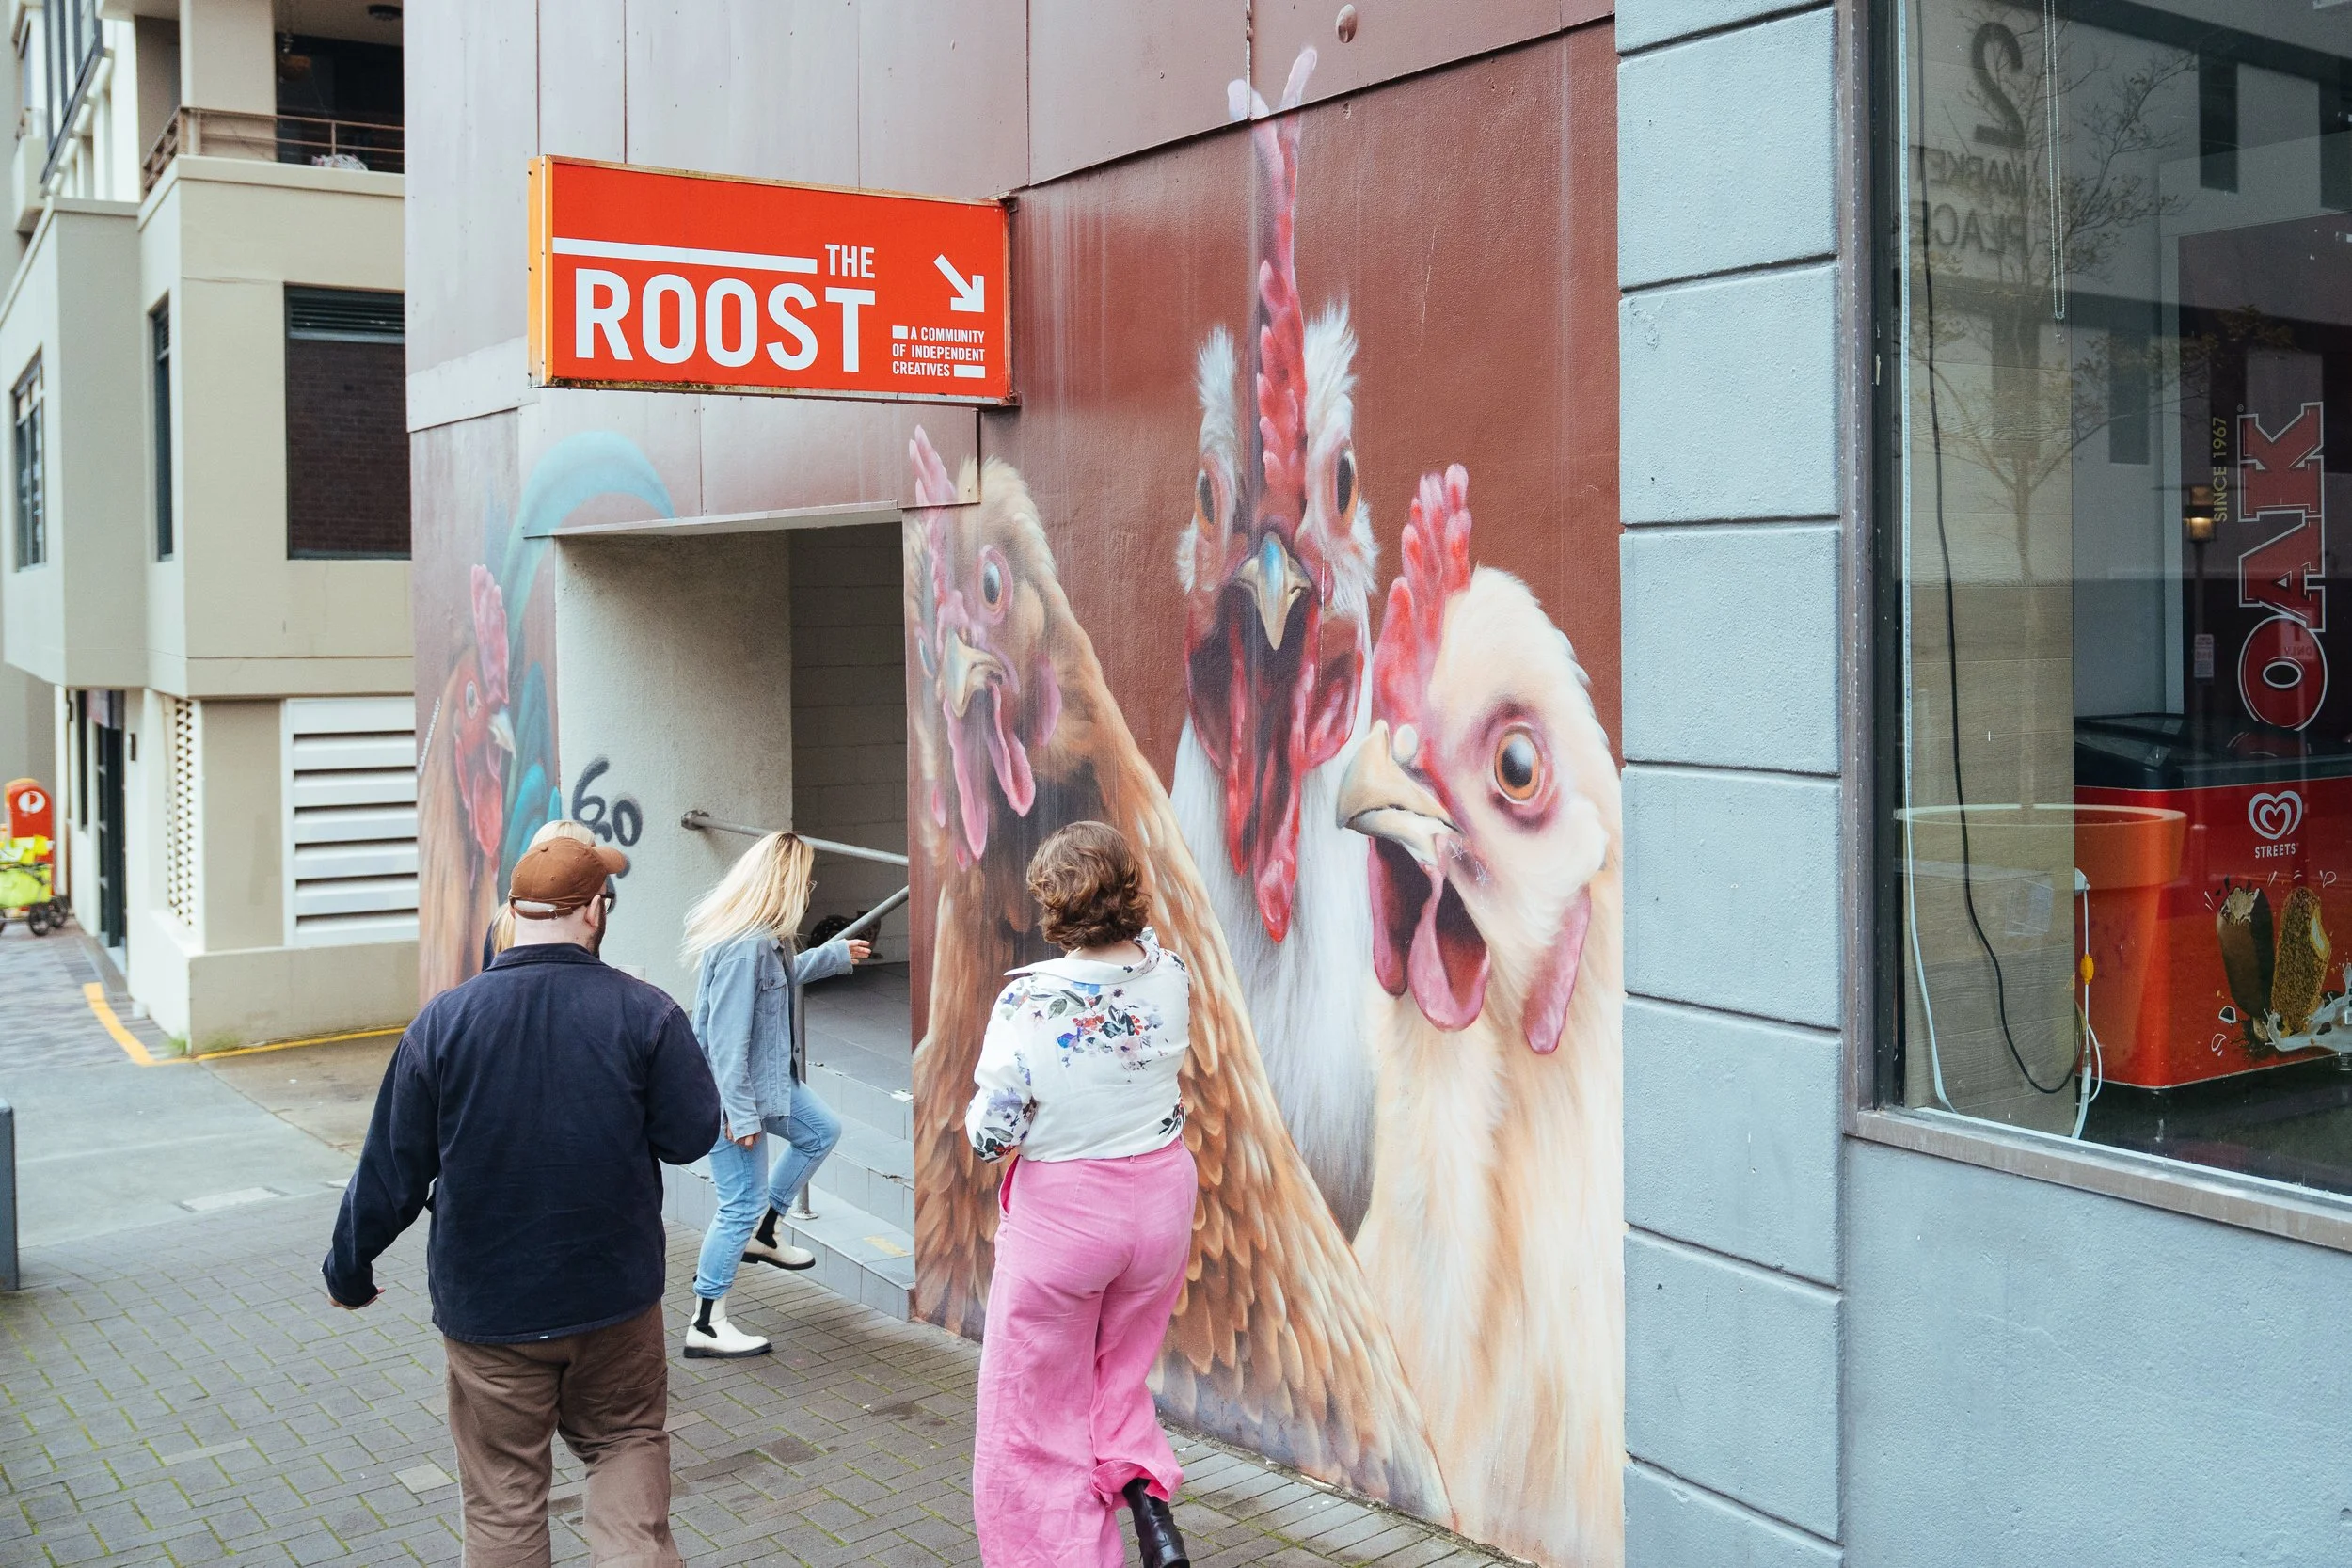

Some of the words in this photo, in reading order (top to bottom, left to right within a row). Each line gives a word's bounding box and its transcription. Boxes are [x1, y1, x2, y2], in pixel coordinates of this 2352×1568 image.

[824, 243, 876, 279] THE
[574, 267, 876, 373] ROOST
[910, 326, 918, 340] A
[920, 326, 985, 344] COMMUNITY
[892, 342, 907, 357] OF
[911, 344, 985, 362] INDEPENDENT
[892, 360, 950, 377] CREATIVES
[2212, 416, 2227, 458] 1967
[2213, 466, 2228, 523] SINCE
[2237, 401, 2328, 733] OAK
[2254, 843, 2296, 859] STREETS
